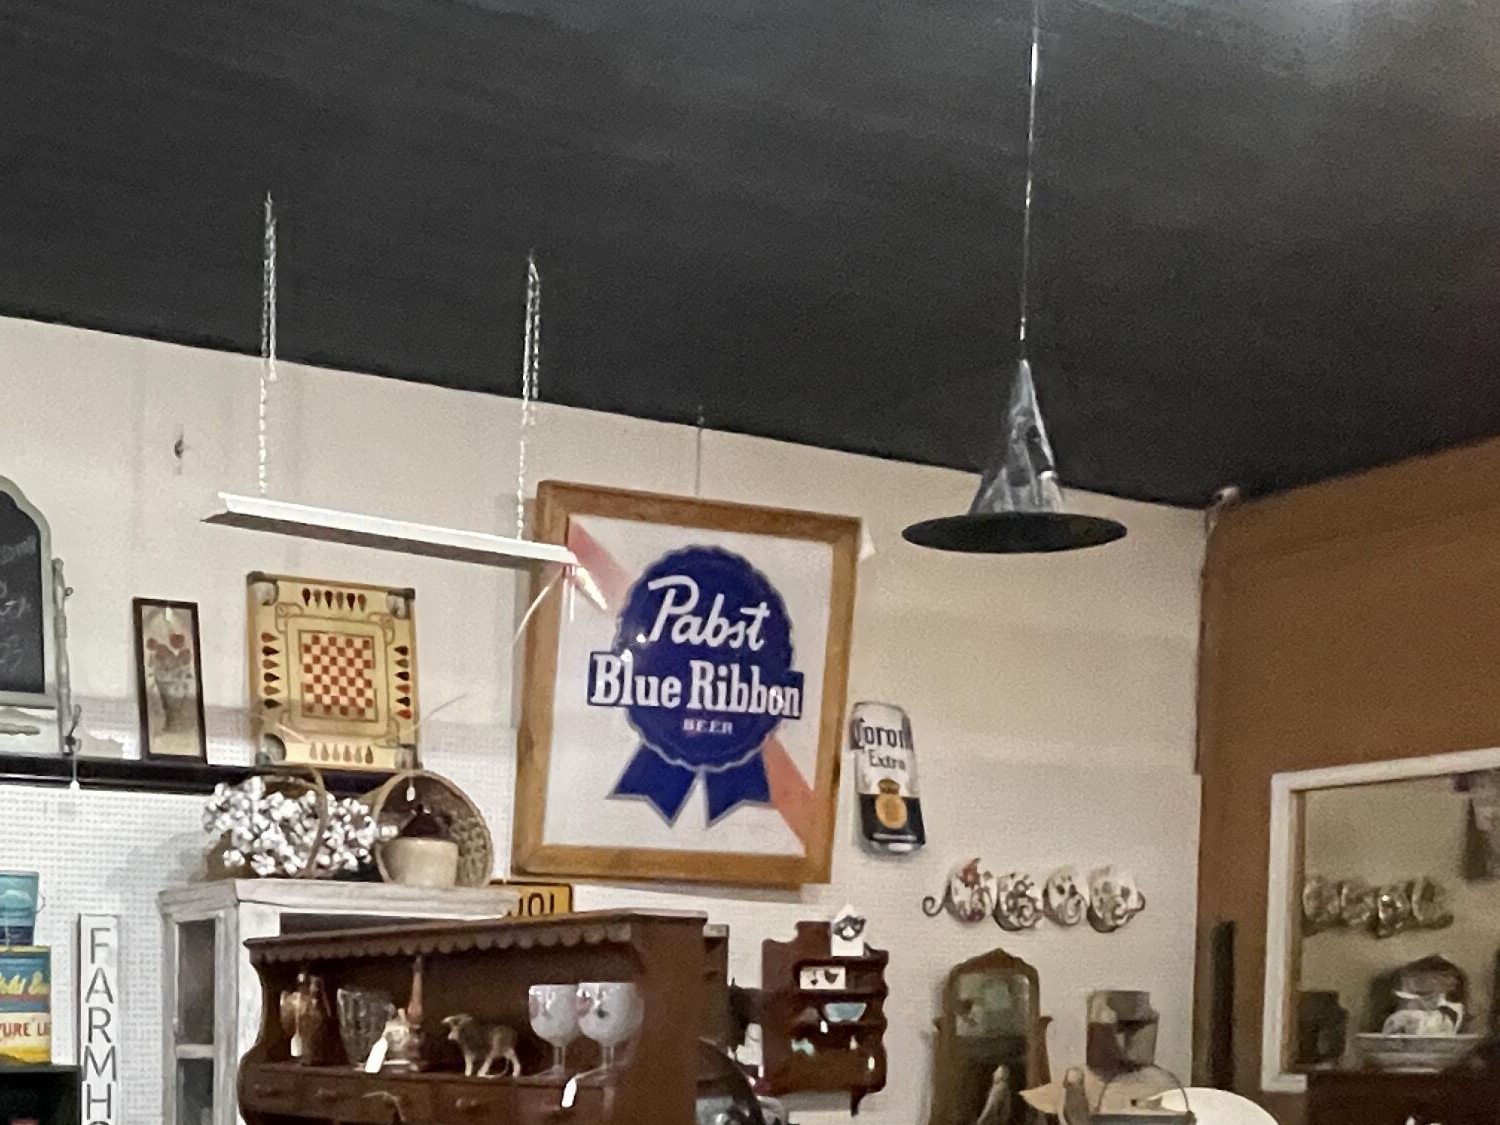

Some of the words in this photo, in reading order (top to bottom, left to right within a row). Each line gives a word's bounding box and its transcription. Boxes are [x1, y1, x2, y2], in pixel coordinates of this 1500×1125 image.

[647, 575, 771, 652] Pabst
[590, 653, 682, 708] Blue
[687, 659, 801, 718] Ribbon
[681, 717, 734, 735] BEER
[869, 749, 906, 771] Extra
